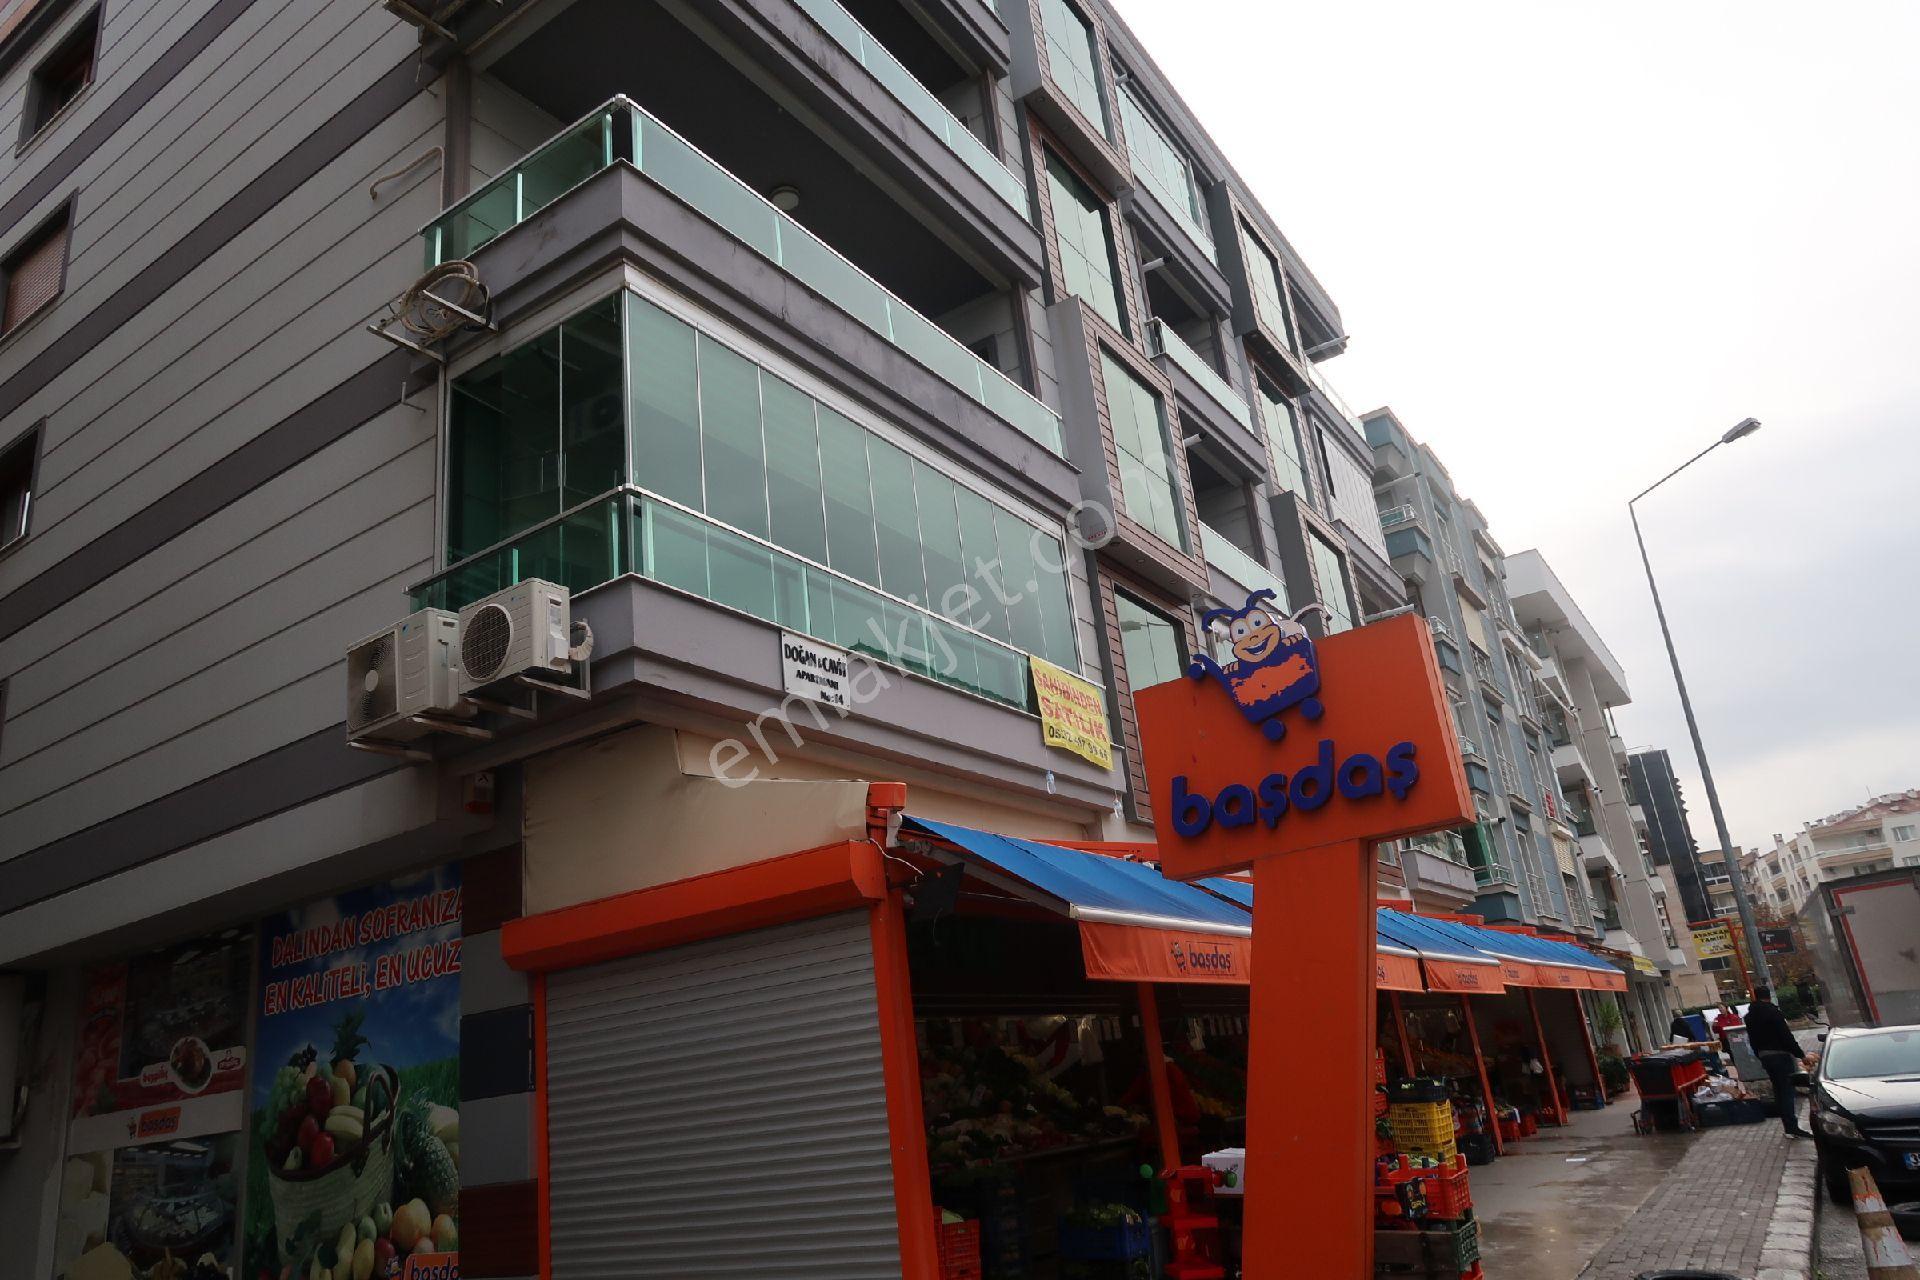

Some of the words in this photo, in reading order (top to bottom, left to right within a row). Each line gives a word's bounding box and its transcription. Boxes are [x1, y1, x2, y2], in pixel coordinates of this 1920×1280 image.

[784, 643, 817, 668] DOĞAN
[1171, 738, 1419, 838] başdaş
[272, 915, 357, 968] DALINDAN
[1188, 943, 1232, 973] başdaş
[264, 979, 288, 1016] EN
[375, 951, 403, 991] EN
[406, 937, 464, 984] UCUZ
